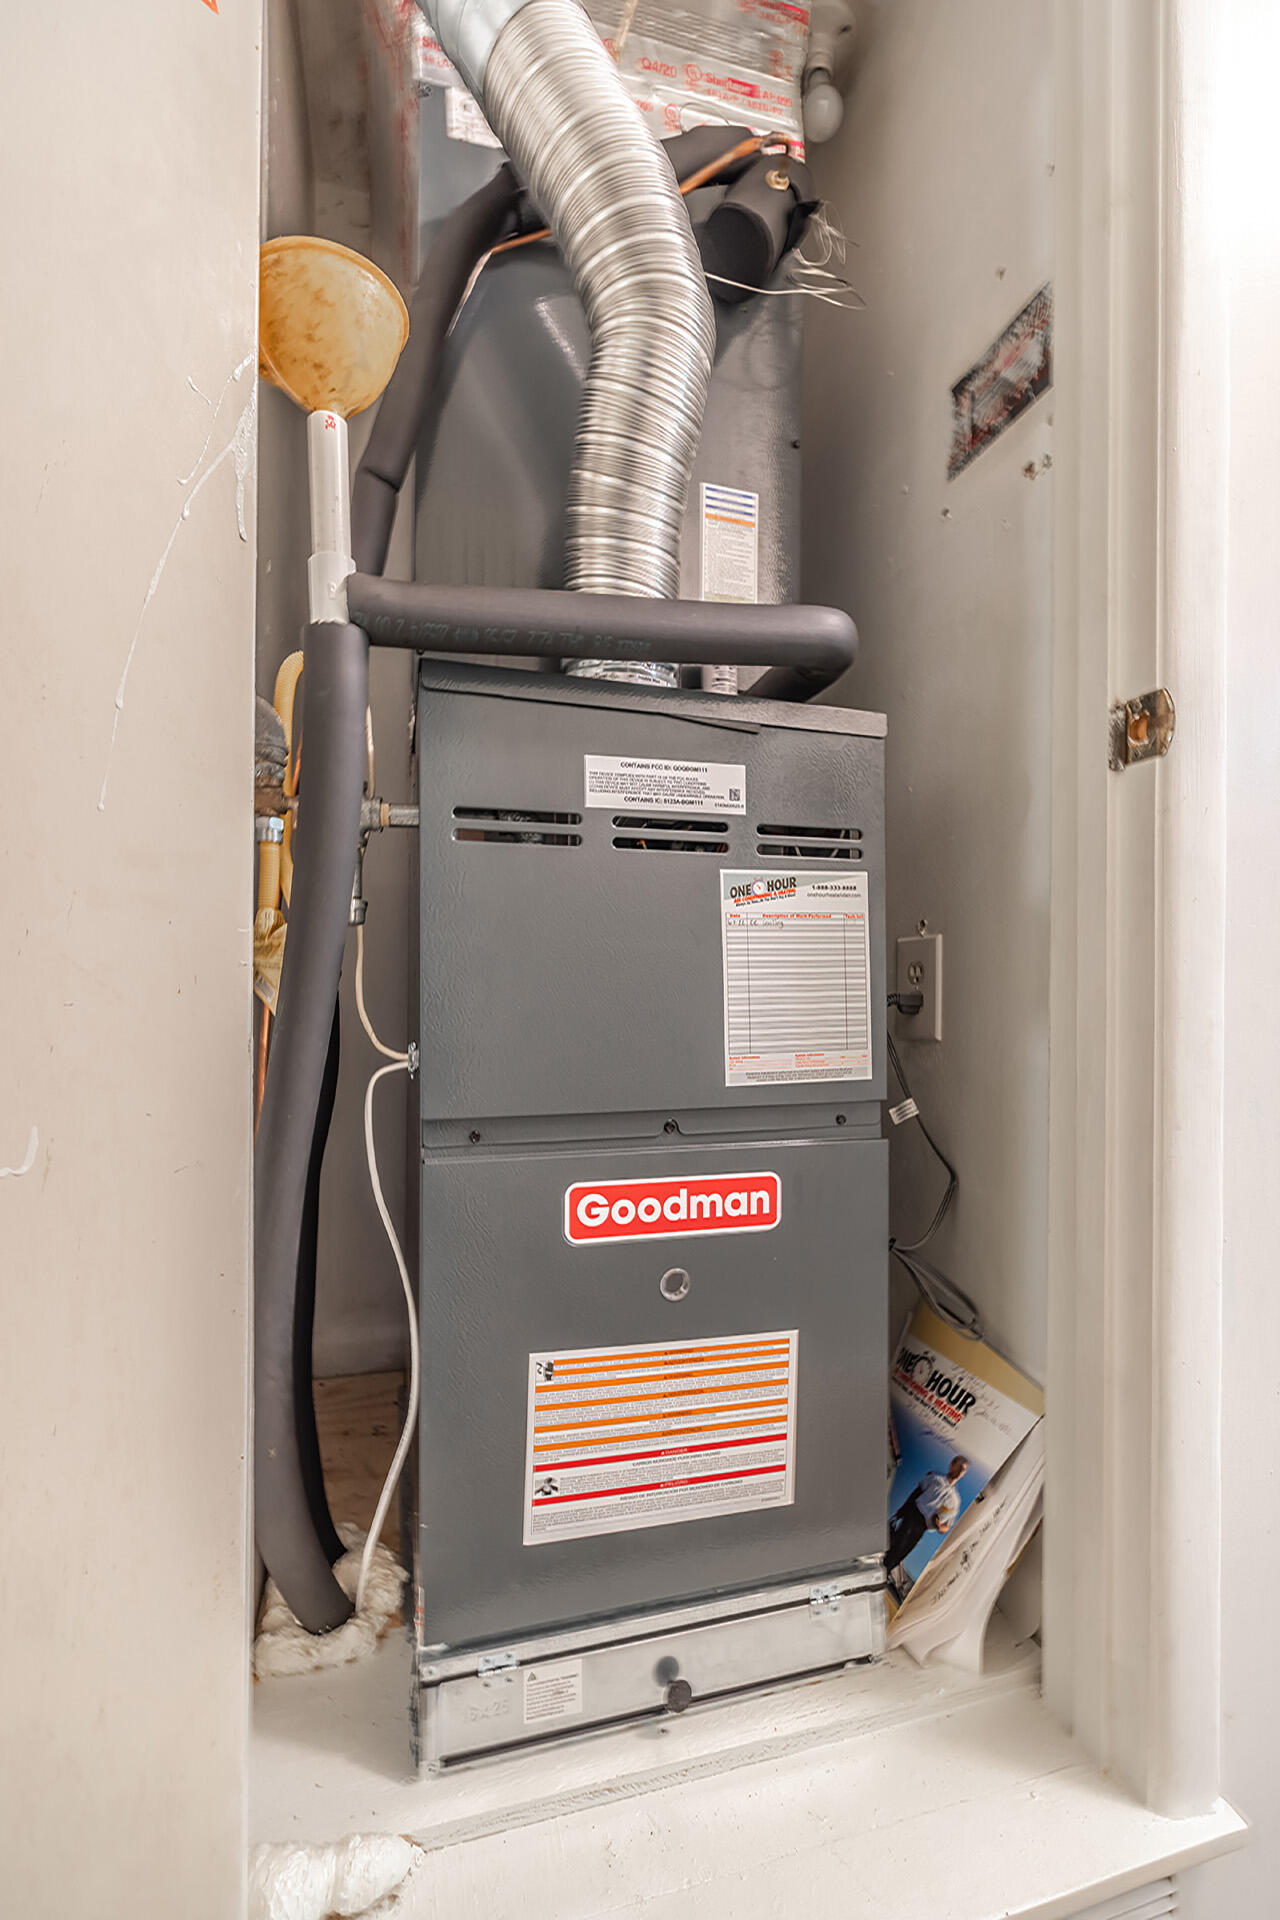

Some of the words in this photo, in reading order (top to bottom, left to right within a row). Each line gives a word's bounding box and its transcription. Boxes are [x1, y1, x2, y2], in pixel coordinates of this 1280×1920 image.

[640, 57, 678, 78] Q4/20
[730, 884, 751, 898] ONE
[767, 877, 797, 891] HOUR
[577, 1188, 770, 1227] Goodman
[925, 1370, 976, 1416] HOUR
[934, 1398, 962, 1423] HEATING
